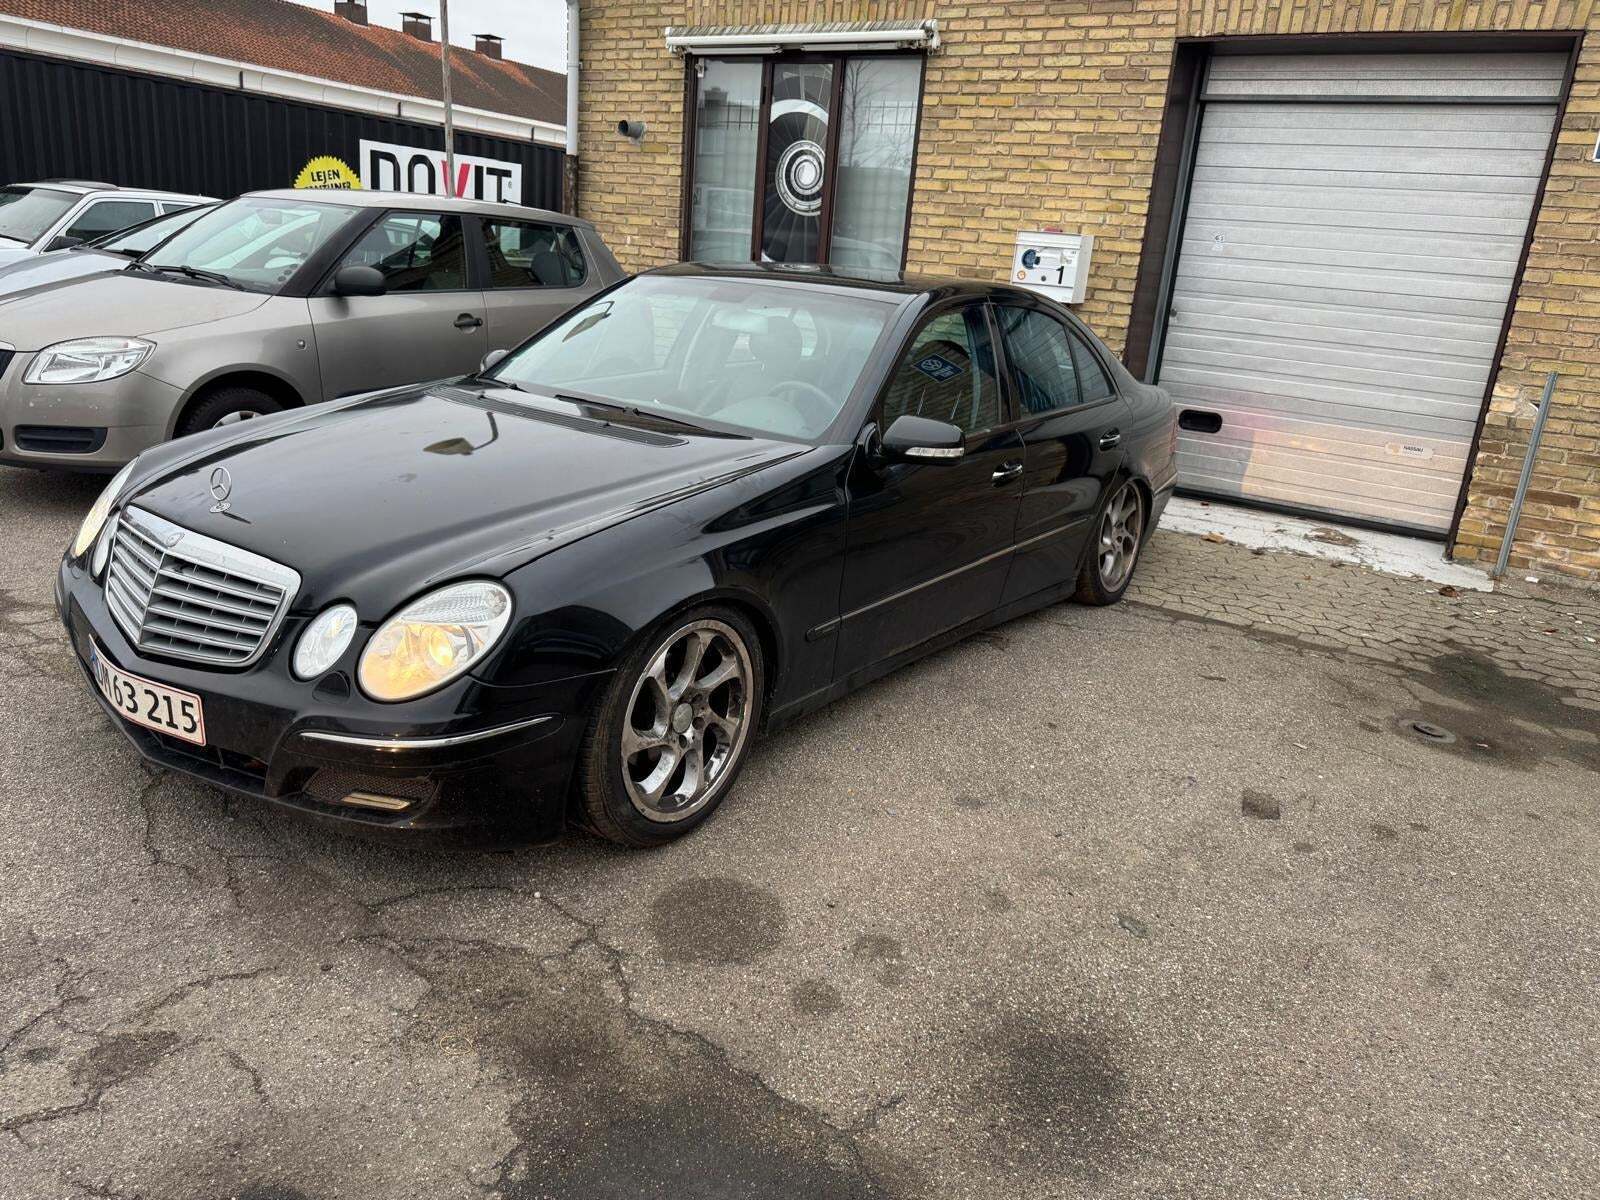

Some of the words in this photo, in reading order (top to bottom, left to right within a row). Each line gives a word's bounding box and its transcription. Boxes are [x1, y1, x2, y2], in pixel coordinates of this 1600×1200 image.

[310, 169, 341, 184] LEJEN
[370, 149, 512, 203] DOVIT
[1056, 265, 1064, 284] 1
[113, 674, 138, 714] 63
[144, 688, 197, 734] 215
